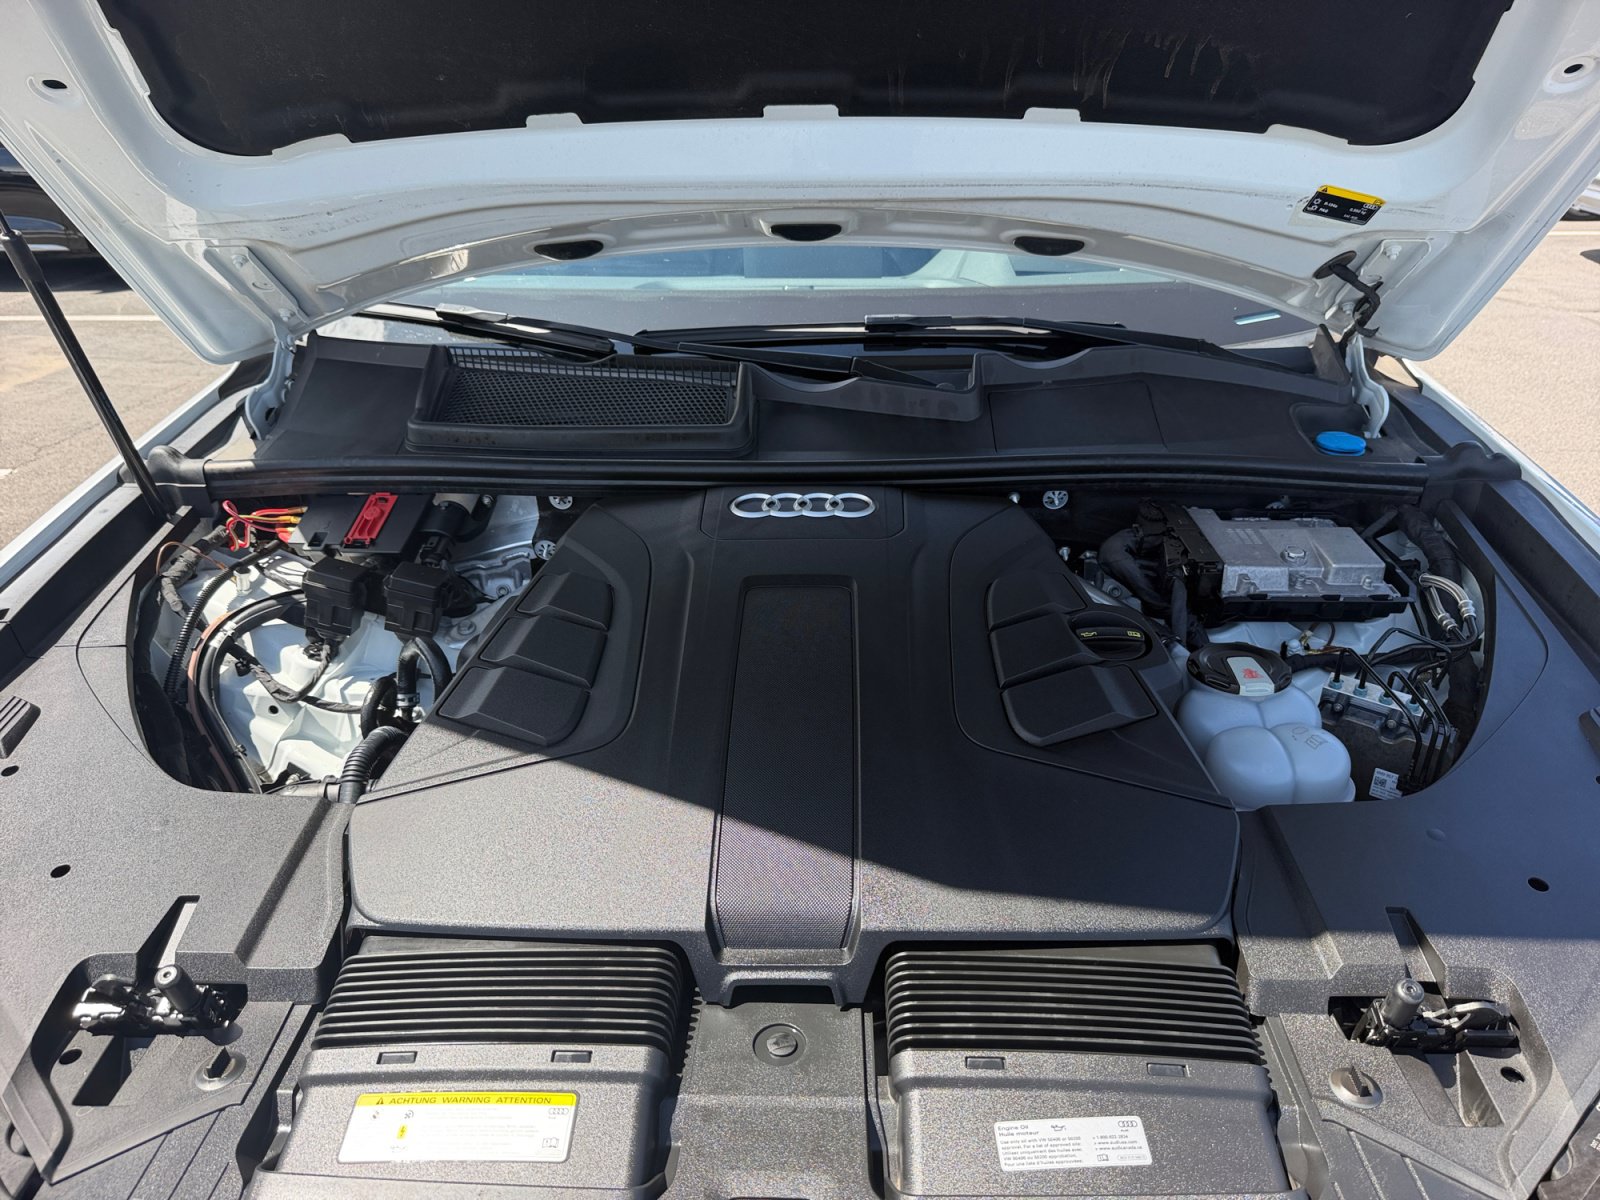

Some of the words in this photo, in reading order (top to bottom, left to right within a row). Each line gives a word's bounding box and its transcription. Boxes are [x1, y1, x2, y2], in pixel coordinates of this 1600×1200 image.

[388, 1096, 437, 1105] ACHTUNG
[442, 1096, 491, 1105] WARNING
[496, 1096, 551, 1105] ATTENTION
